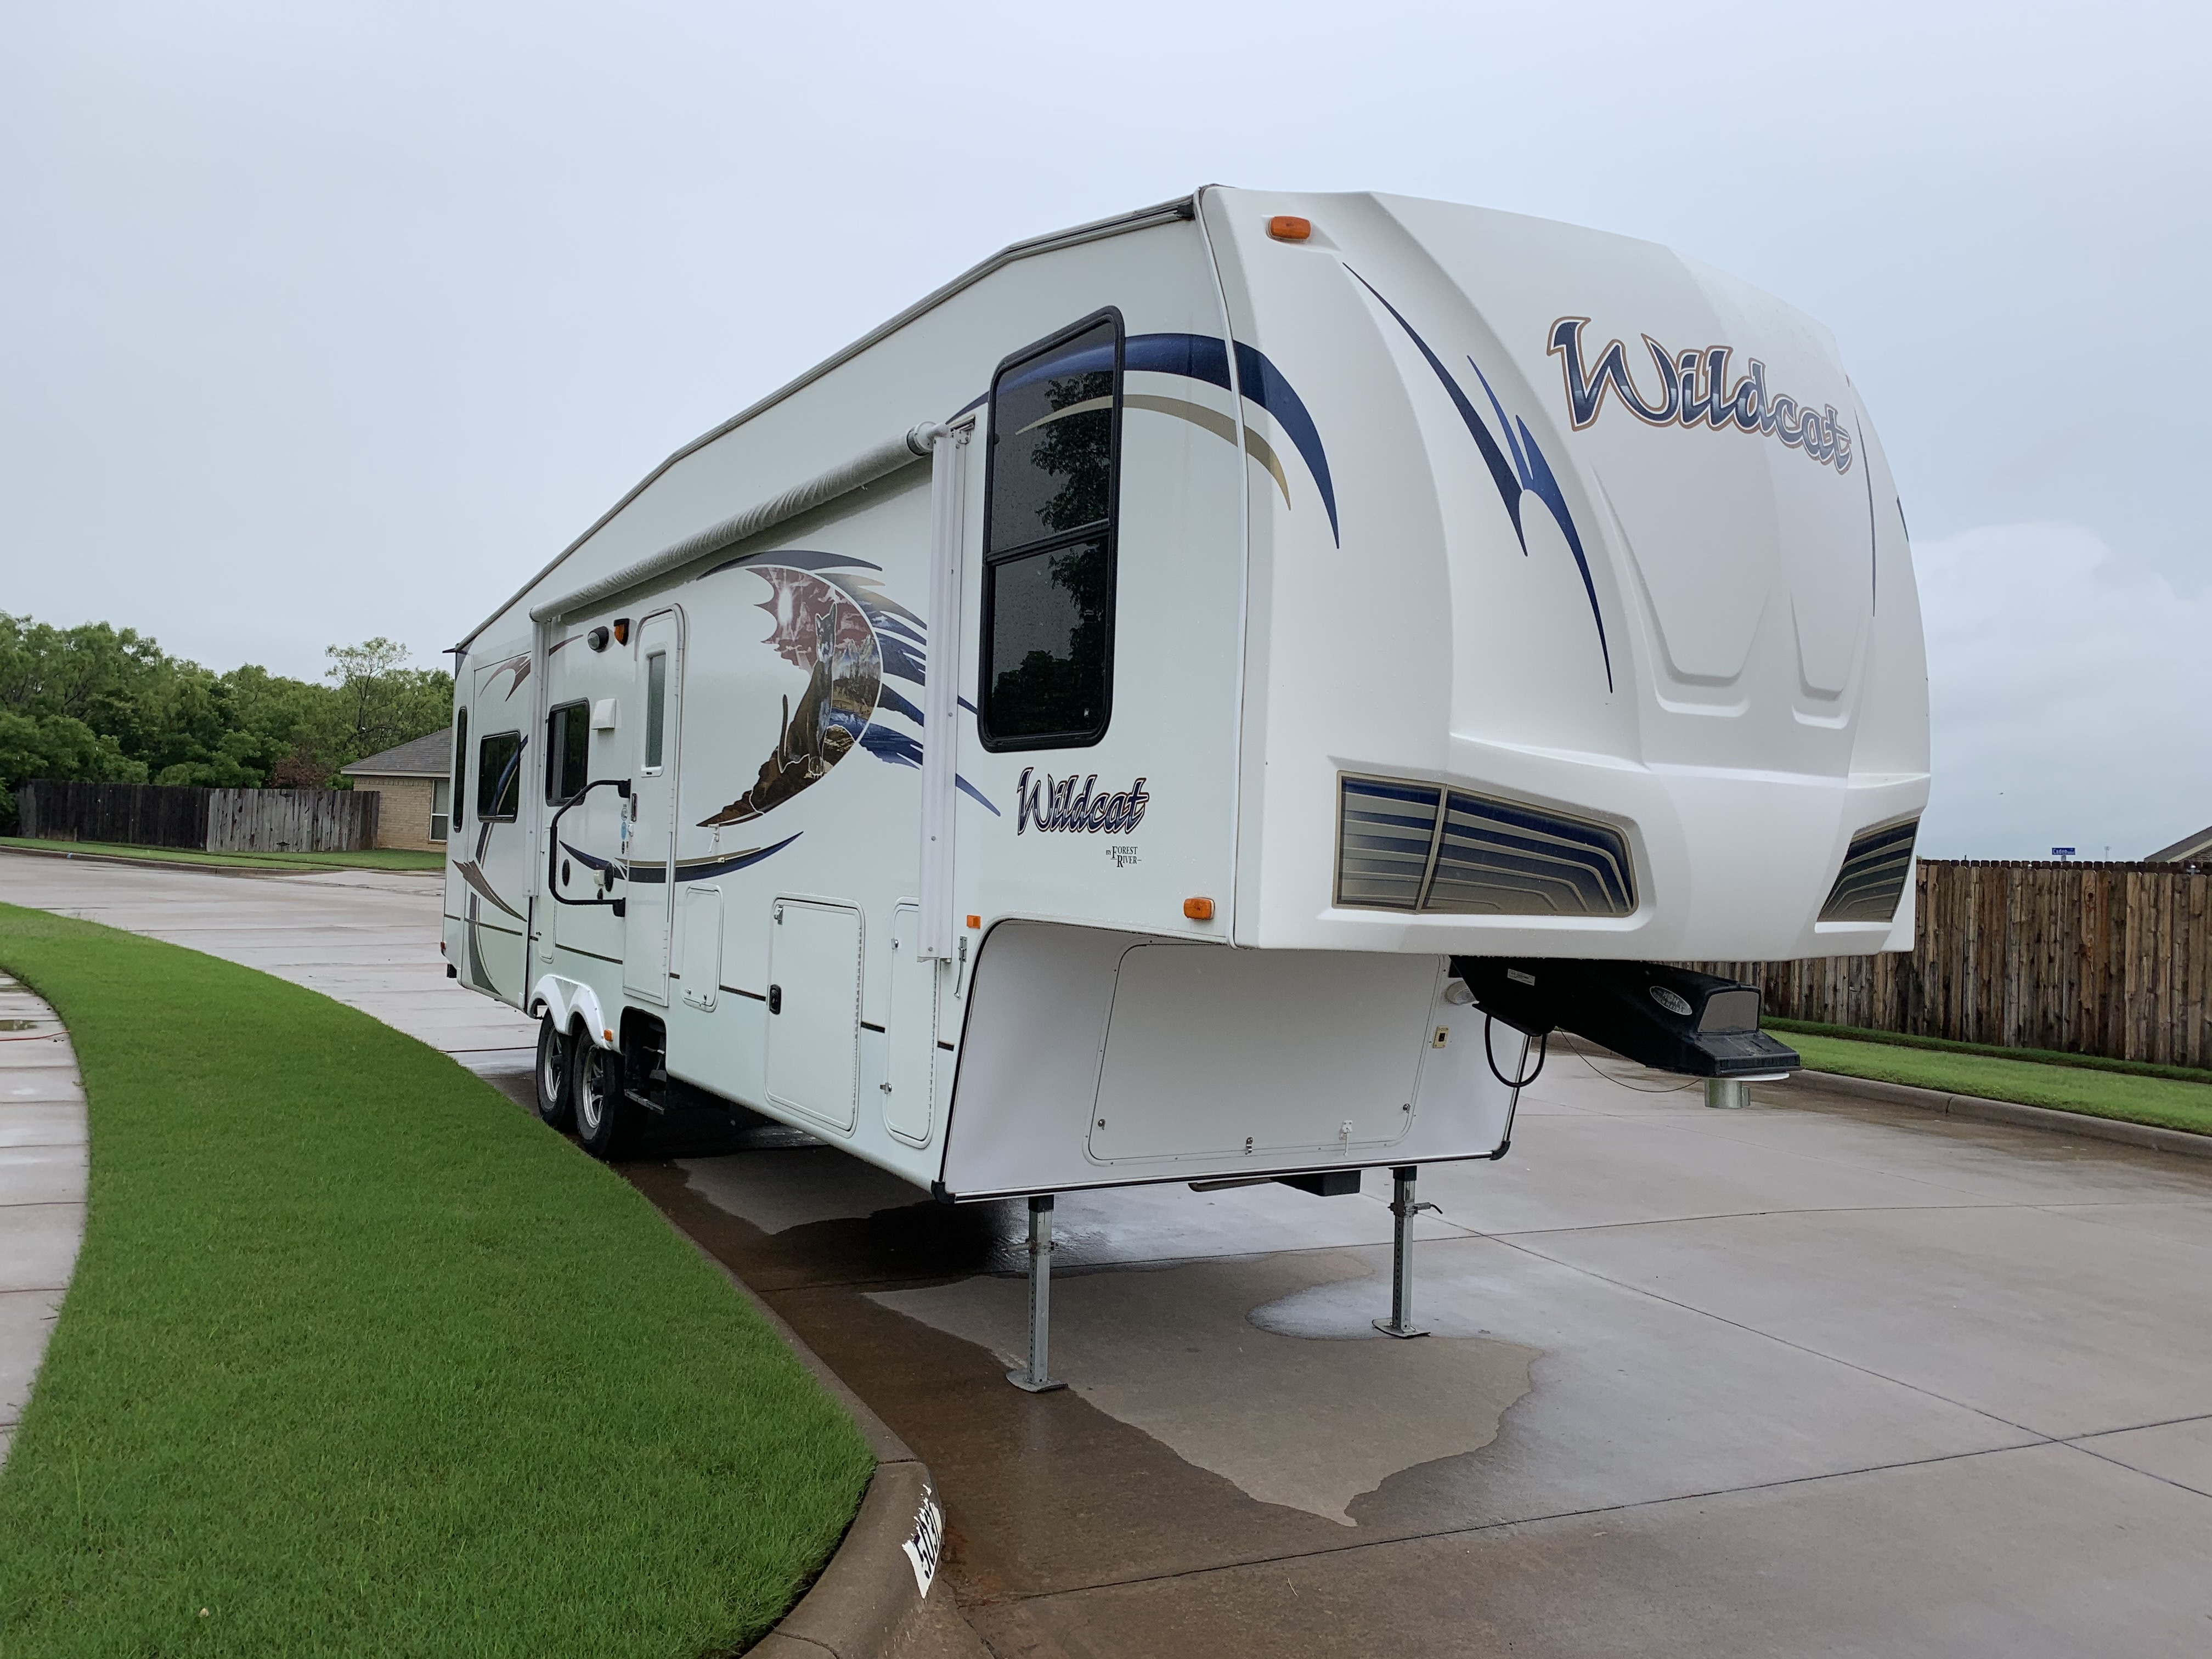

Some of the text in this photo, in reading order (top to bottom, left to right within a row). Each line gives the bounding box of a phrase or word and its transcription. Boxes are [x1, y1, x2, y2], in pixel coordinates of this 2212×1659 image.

[1547, 316, 1852, 475] Wildcat
[1017, 767, 1150, 836] Wildcat
[1112, 846, 1138, 858] FOREST
[1116, 855, 1137, 867] RIVER
